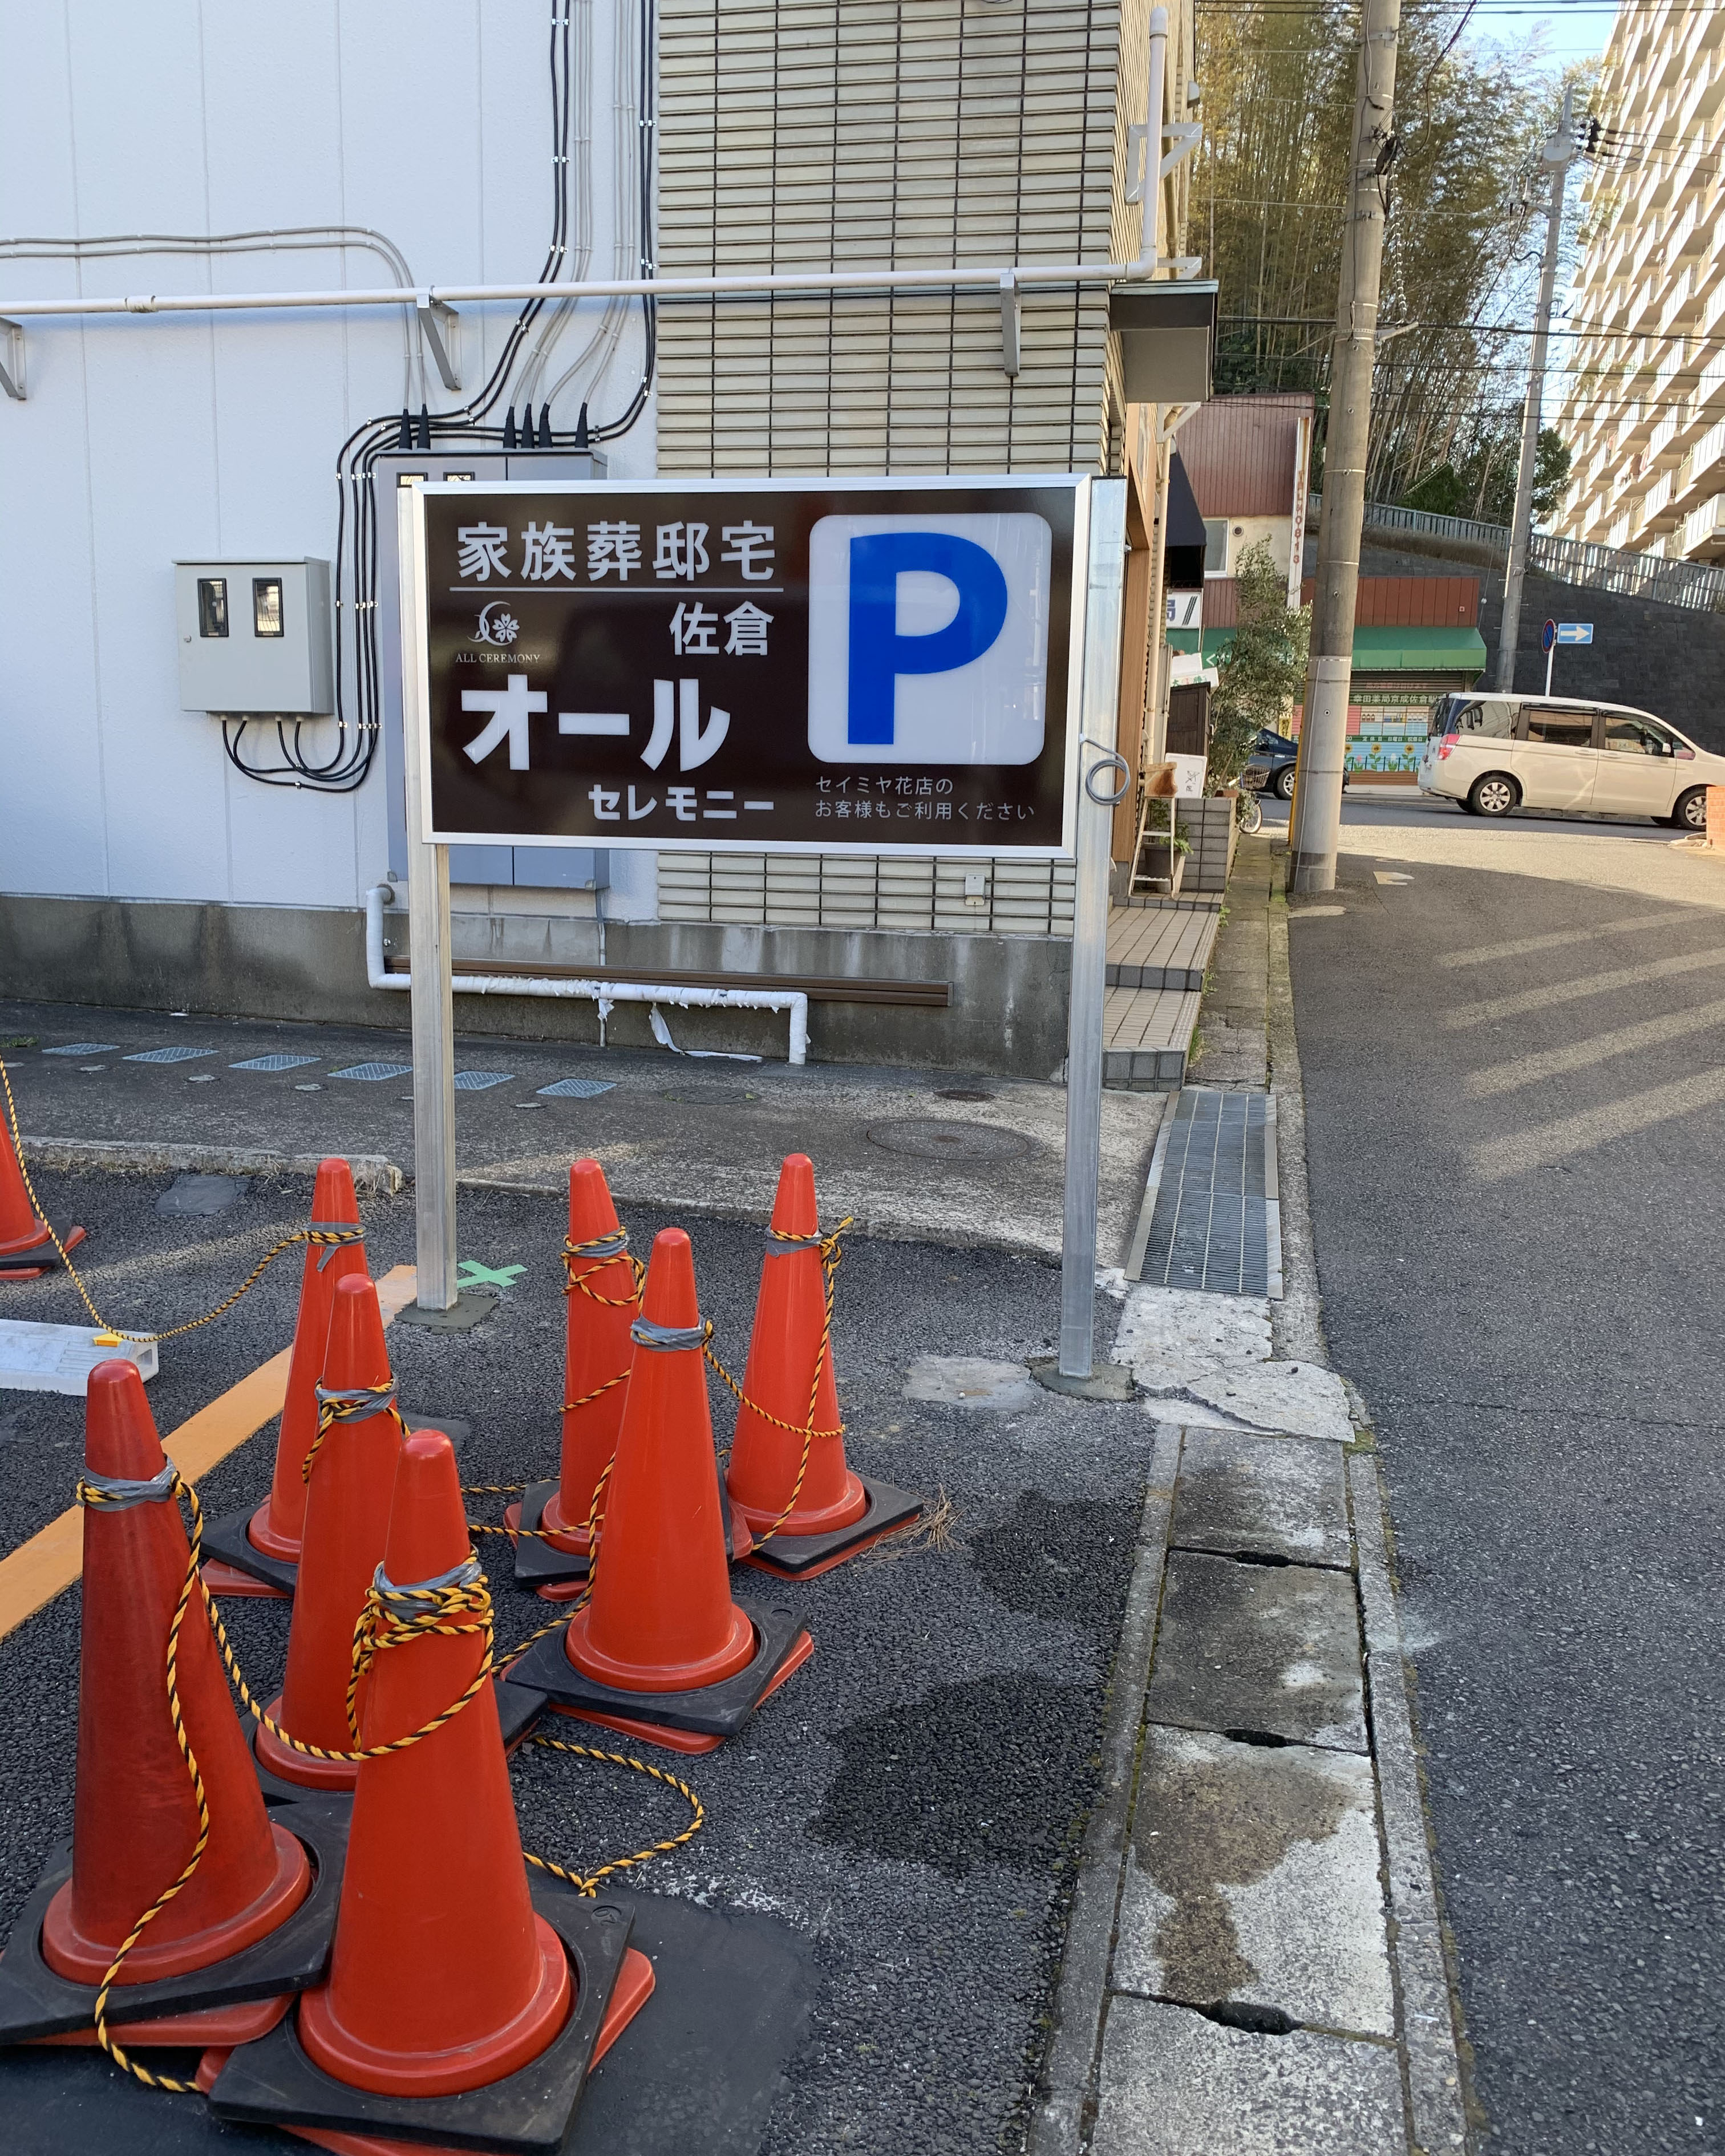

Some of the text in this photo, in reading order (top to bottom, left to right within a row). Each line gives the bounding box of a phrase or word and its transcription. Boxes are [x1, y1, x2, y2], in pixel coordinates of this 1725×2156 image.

[457, 520, 775, 582] 家族葬邸宅
[669, 601, 774, 655] 佐倉
[847, 532, 1008, 744] P
[456, 653, 541, 663] ALL CEREMONY
[461, 674, 730, 772] オール
[588, 784, 774, 821] セレモニー
[816, 776, 953, 795] セイミヤ花店の
[815, 800, 1034, 821] お客様もご利用ください
